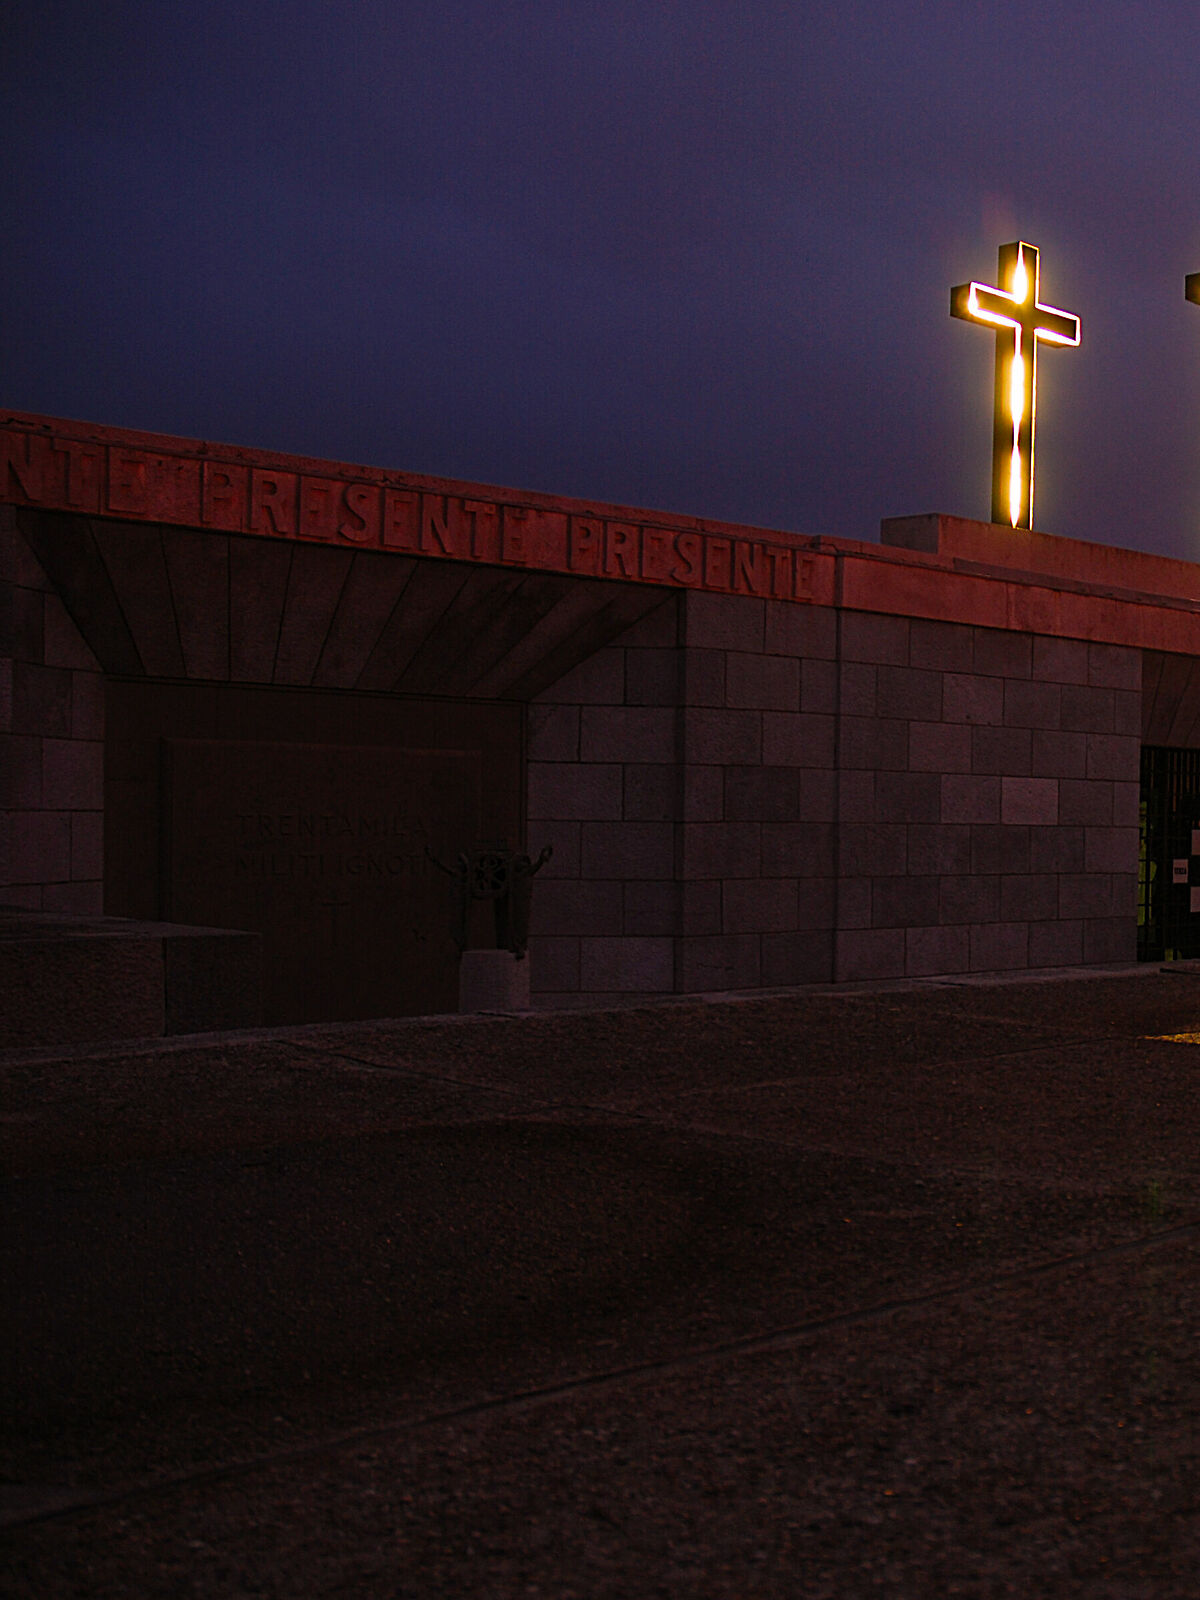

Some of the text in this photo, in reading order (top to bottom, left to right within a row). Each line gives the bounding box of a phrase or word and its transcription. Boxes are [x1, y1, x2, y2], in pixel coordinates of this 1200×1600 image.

[199, 459, 528, 564] PRESENTE
[567, 514, 813, 601] PRESENTE
[235, 813, 429, 837] TRENTAMILA
[234, 853, 325, 877] MILITI
